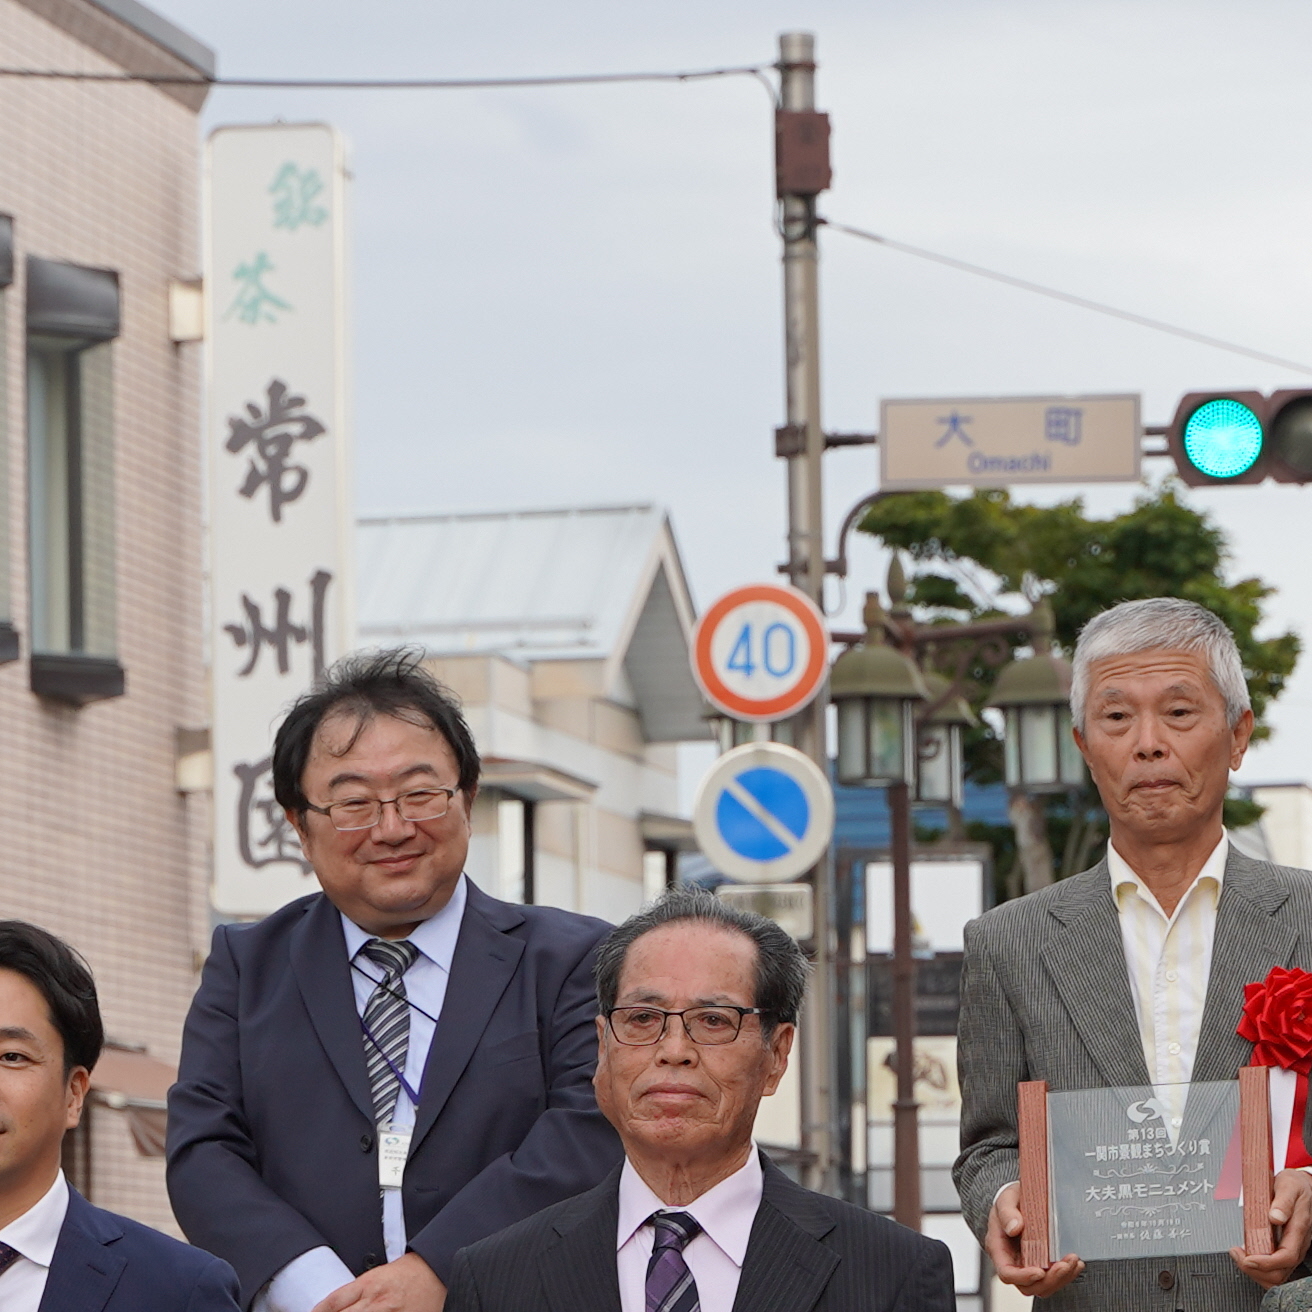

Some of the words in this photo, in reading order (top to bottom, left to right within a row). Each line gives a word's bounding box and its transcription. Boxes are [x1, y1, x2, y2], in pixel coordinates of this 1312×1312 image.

[222, 160, 331, 326] 銘茶
[934, 405, 1084, 449] 大町
[967, 451, 1051, 474] Omachi
[726, 621, 795, 680] 40
[1085, 1178, 1213, 1201] 大夫黒モニュメント
